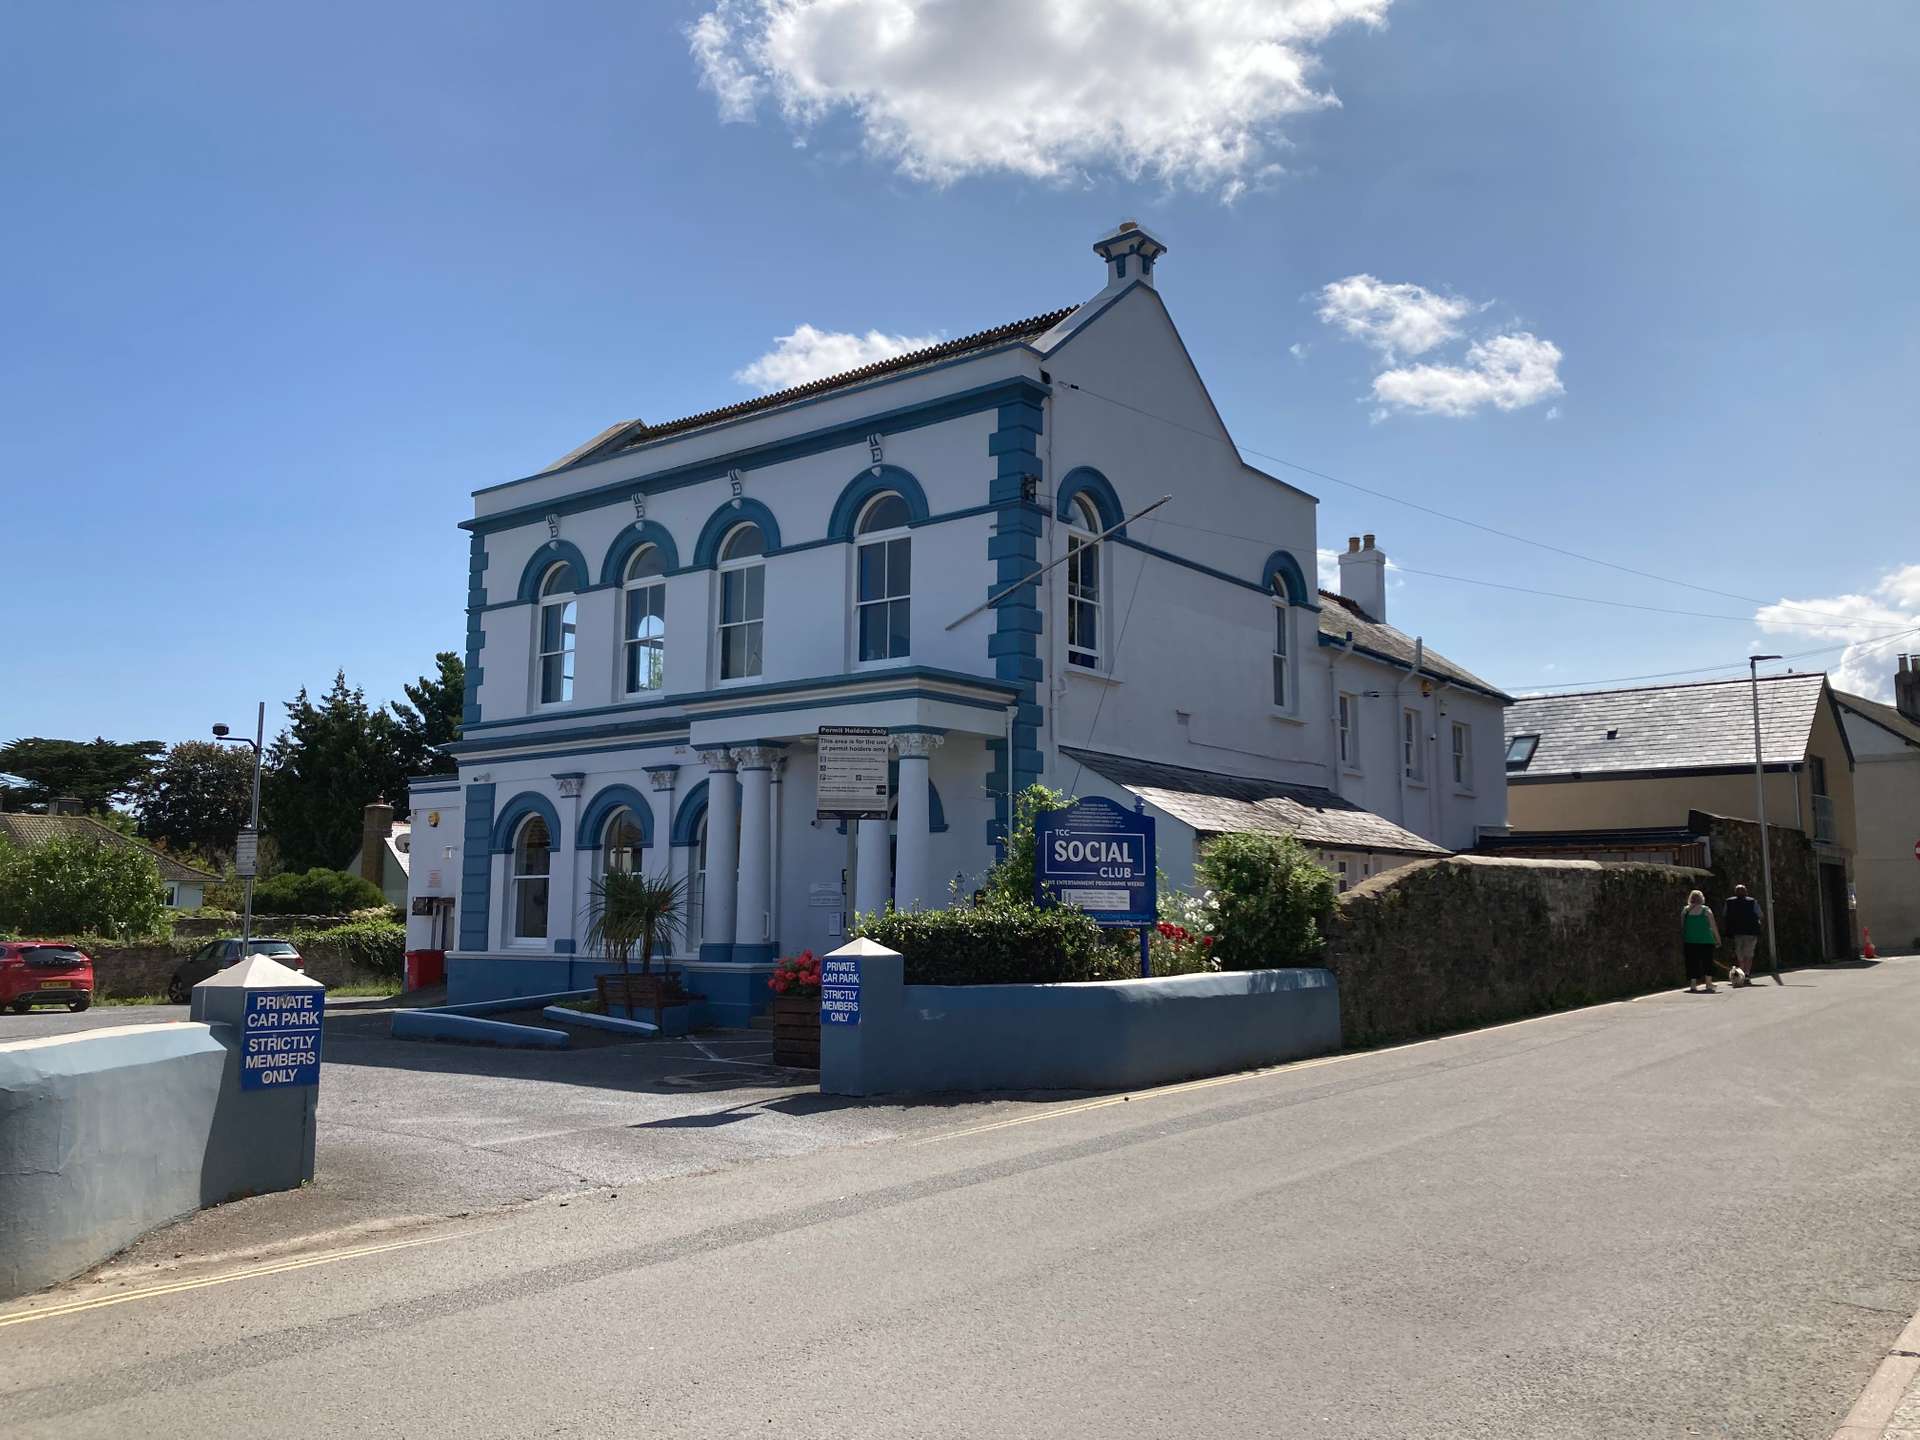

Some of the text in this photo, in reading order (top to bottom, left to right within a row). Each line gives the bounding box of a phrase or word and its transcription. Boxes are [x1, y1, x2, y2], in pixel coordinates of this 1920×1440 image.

[872, 728, 887, 736] Only
[1054, 840, 1134, 863] SOCIAL
[1099, 867, 1131, 878] CLUB
[826, 962, 855, 972] PRIVATE
[822, 973, 860, 983] CAR PARK
[823, 990, 857, 1000] STRICTLY
[256, 995, 313, 1010] PRIVATE
[822, 1001, 858, 1012] MEMBERS
[247, 1011, 320, 1028] CAR PARK
[830, 1012, 850, 1022] ONLY
[248, 1036, 316, 1052] STRICTLY
[245, 1052, 316, 1069] MEMBERS
[261, 1069, 298, 1084] ONLY
